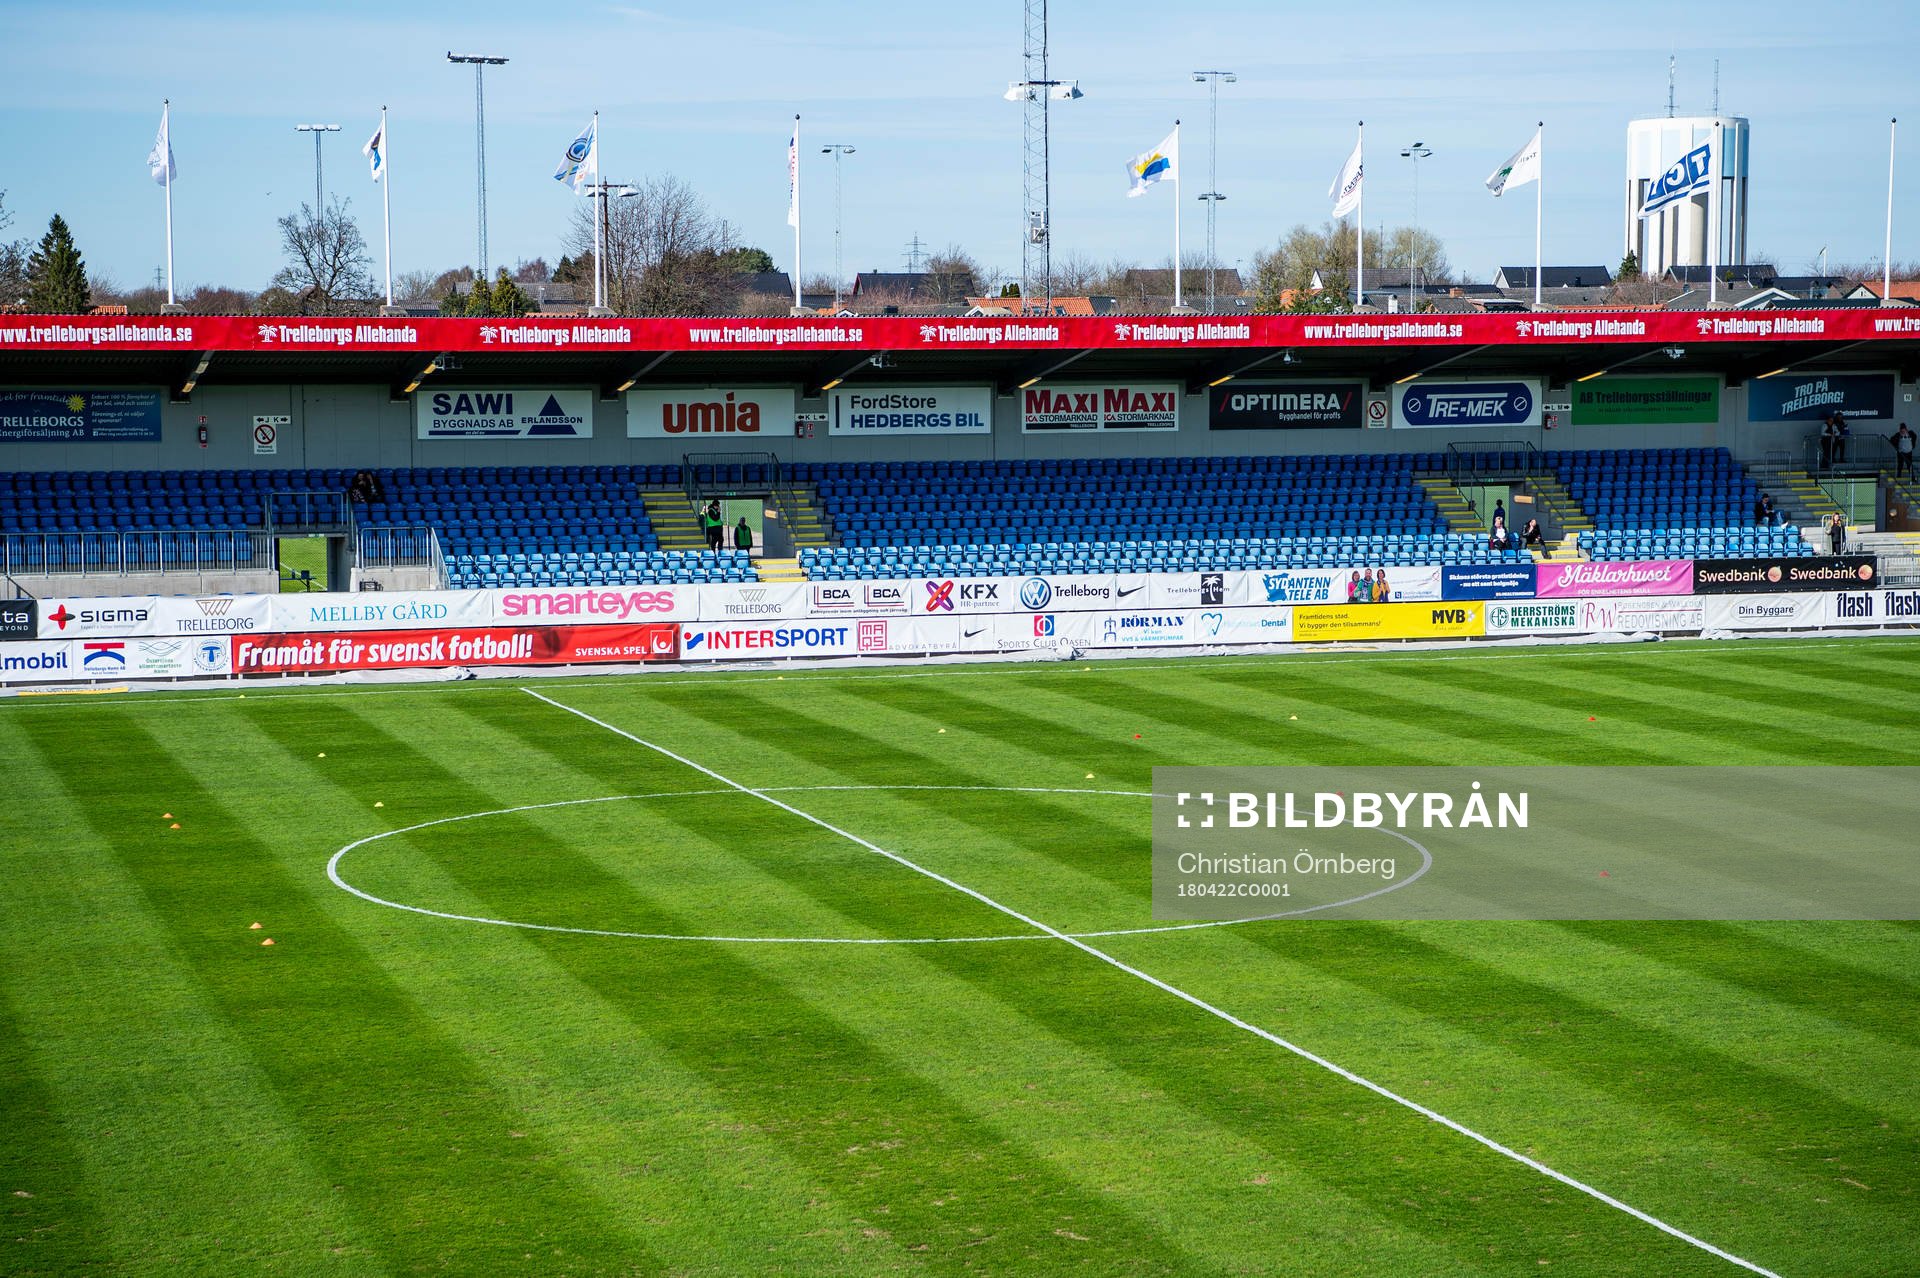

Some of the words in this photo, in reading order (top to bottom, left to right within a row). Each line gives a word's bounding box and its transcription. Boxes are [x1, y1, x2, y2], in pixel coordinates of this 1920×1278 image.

[1132, 324, 1194, 342] Trelleborgs
[1197, 323, 1250, 340] Allehanda
[1304, 322, 1463, 340] www.trelleborgsallehanda.se
[1532, 320, 1592, 337] Trelleborgs
[1594, 320, 1645, 335] Allehanda
[1713, 318, 1772, 335] Trelleborgs
[1774, 317, 1824, 333] Allehanda
[0, 325, 192, 344] ww.trelleborgsallehanda.se
[279, 325, 353, 344] Trelleborgs
[355, 325, 417, 343] Allehanda
[500, 326, 569, 345] Trelleborgs
[572, 326, 631, 343] Allehanda
[690, 327, 863, 345] www.trelleborgsallehanda.se
[938, 325, 1002, 344] Trelleborgs
[1004, 325, 1059, 342] Allehanda
[1795, 382, 1814, 398] TRO
[1815, 377, 1829, 393] PÅ
[433, 393, 513, 415] SAWI
[851, 394, 937, 409] FordStore
[1231, 393, 1341, 411] OPTIMERA
[1580, 392, 1593, 403] AB
[1596, 390, 1712, 405] Trelleborgsställningar
[1781, 391, 1845, 416] TRELLEBORG!
[663, 391, 760, 433] umia
[1427, 393, 1508, 418] TRE-MEK
[433, 420, 496, 429] BYGGNADS
[499, 419, 514, 428] AB
[851, 413, 951, 428] HEDBERGS
[955, 413, 984, 427] BIL
[1117, 413, 1175, 421] STORMARKNAD
[1279, 413, 1312, 421] Bygghandel
[1323, 413, 1341, 421] proffs
[72, 429, 84, 437] AB
[1558, 564, 1672, 588] Mäklarhuset
[1699, 568, 1766, 583] Swedbank
[1790, 567, 1856, 580] Swedbank
[823, 589, 850, 598] BCA
[873, 588, 901, 598] BCA
[960, 584, 998, 599] KFX
[1055, 585, 1110, 598] Trelleborg
[1288, 589, 1315, 600] TELE
[1316, 589, 1329, 600] AB
[310, 606, 388, 622] MELLBY
[393, 601, 447, 620] GÅRD
[502, 590, 675, 619] smarteyes
[725, 603, 782, 614] TRELLEBORG
[960, 600, 1000, 608] HR-partner
[1511, 604, 1575, 617] HERRSTRÖMS
[1739, 606, 1754, 614] Din
[1756, 604, 1795, 617] Byggare
[176, 617, 254, 631] TRELLEBORG
[1121, 615, 1185, 628] RÖRMAN
[1261, 619, 1287, 627] Dental
[1343, 620, 1381, 628] tillsammans!
[1432, 609, 1466, 624] MVB
[1510, 616, 1575, 627] MEKANISKA
[1617, 612, 1687, 628] REDOVISNING
[1690, 612, 1703, 627] AB
[707, 628, 849, 650] INTERSPORT
[889, 642, 957, 650] ADVOKATBYRÅ
[238, 639, 325, 667] Framåt
[328, 639, 365, 664] för
[367, 636, 445, 662] svensk
[449, 634, 533, 661] fotboll!
[575, 647, 621, 657] SVENSKA
[623, 646, 647, 655] SPEL
